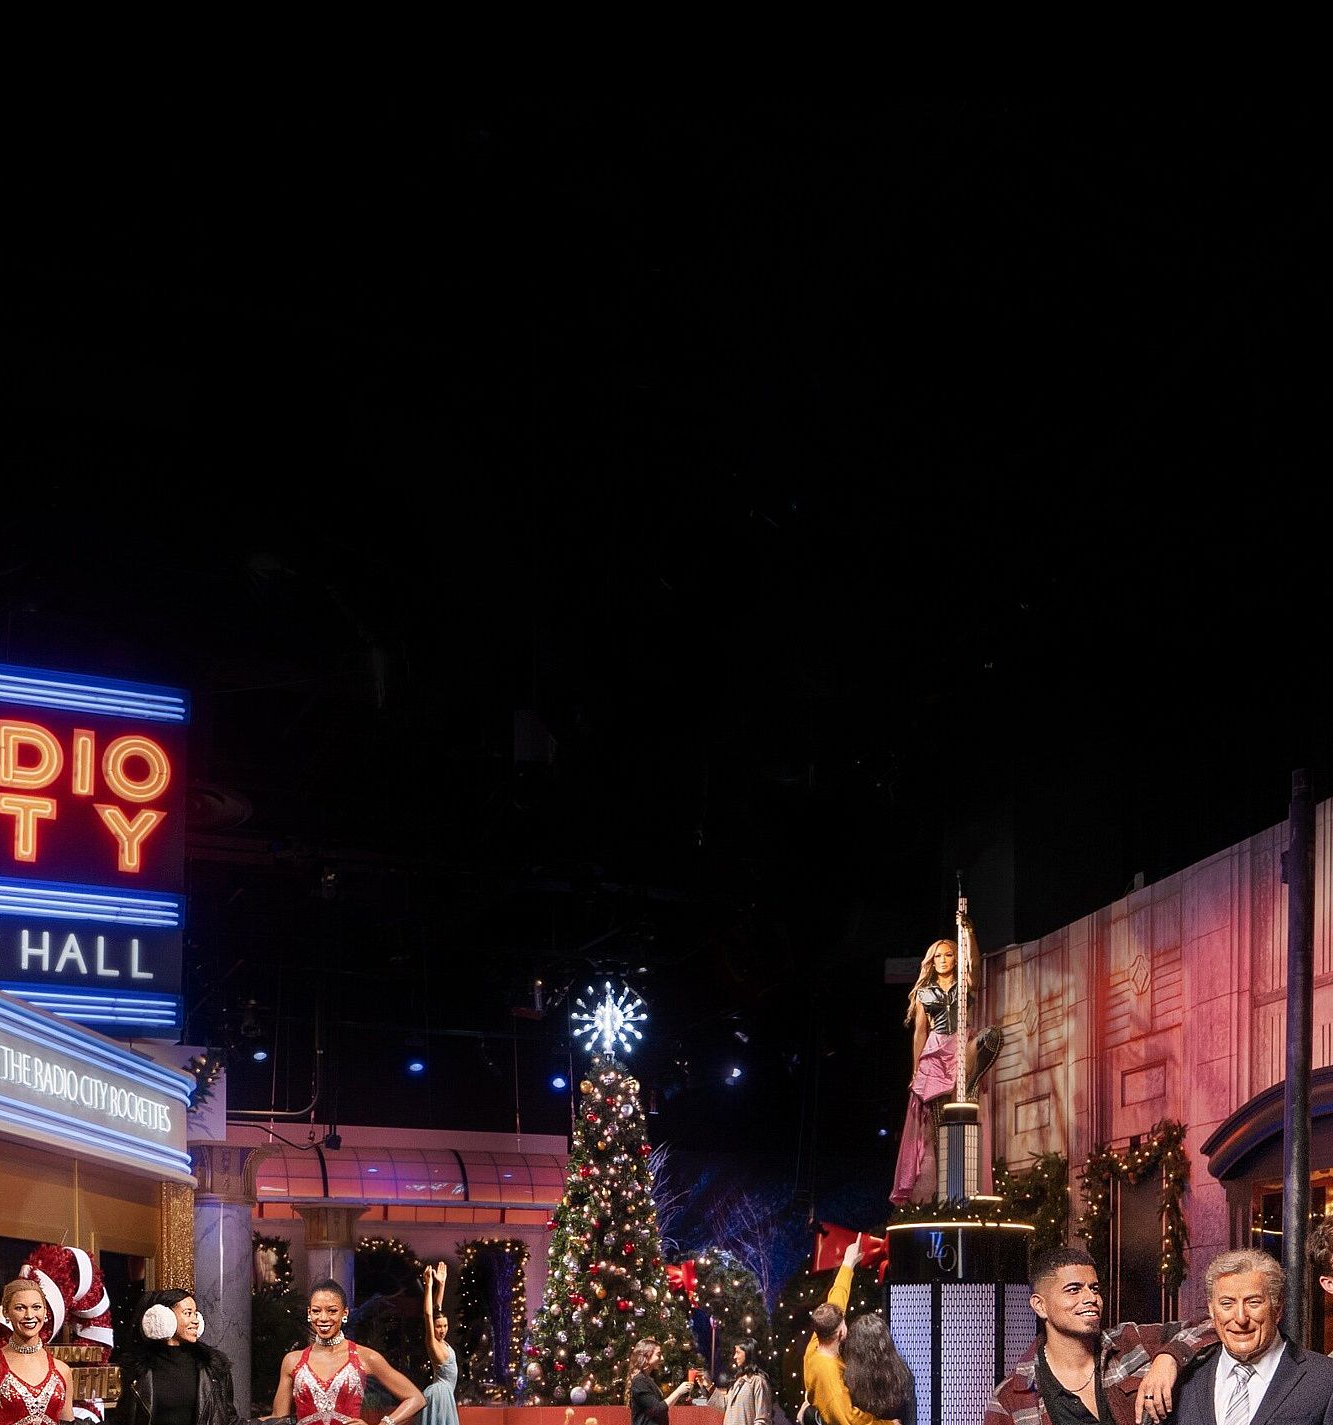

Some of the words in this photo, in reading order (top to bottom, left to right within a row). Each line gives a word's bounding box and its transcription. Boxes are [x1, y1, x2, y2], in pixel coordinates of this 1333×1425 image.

[21, 929, 154, 980] HALL
[34, 1057, 78, 1101] RADIO
[81, 1075, 109, 1110] CITY
[109, 1085, 172, 1133] ROCKETTES
